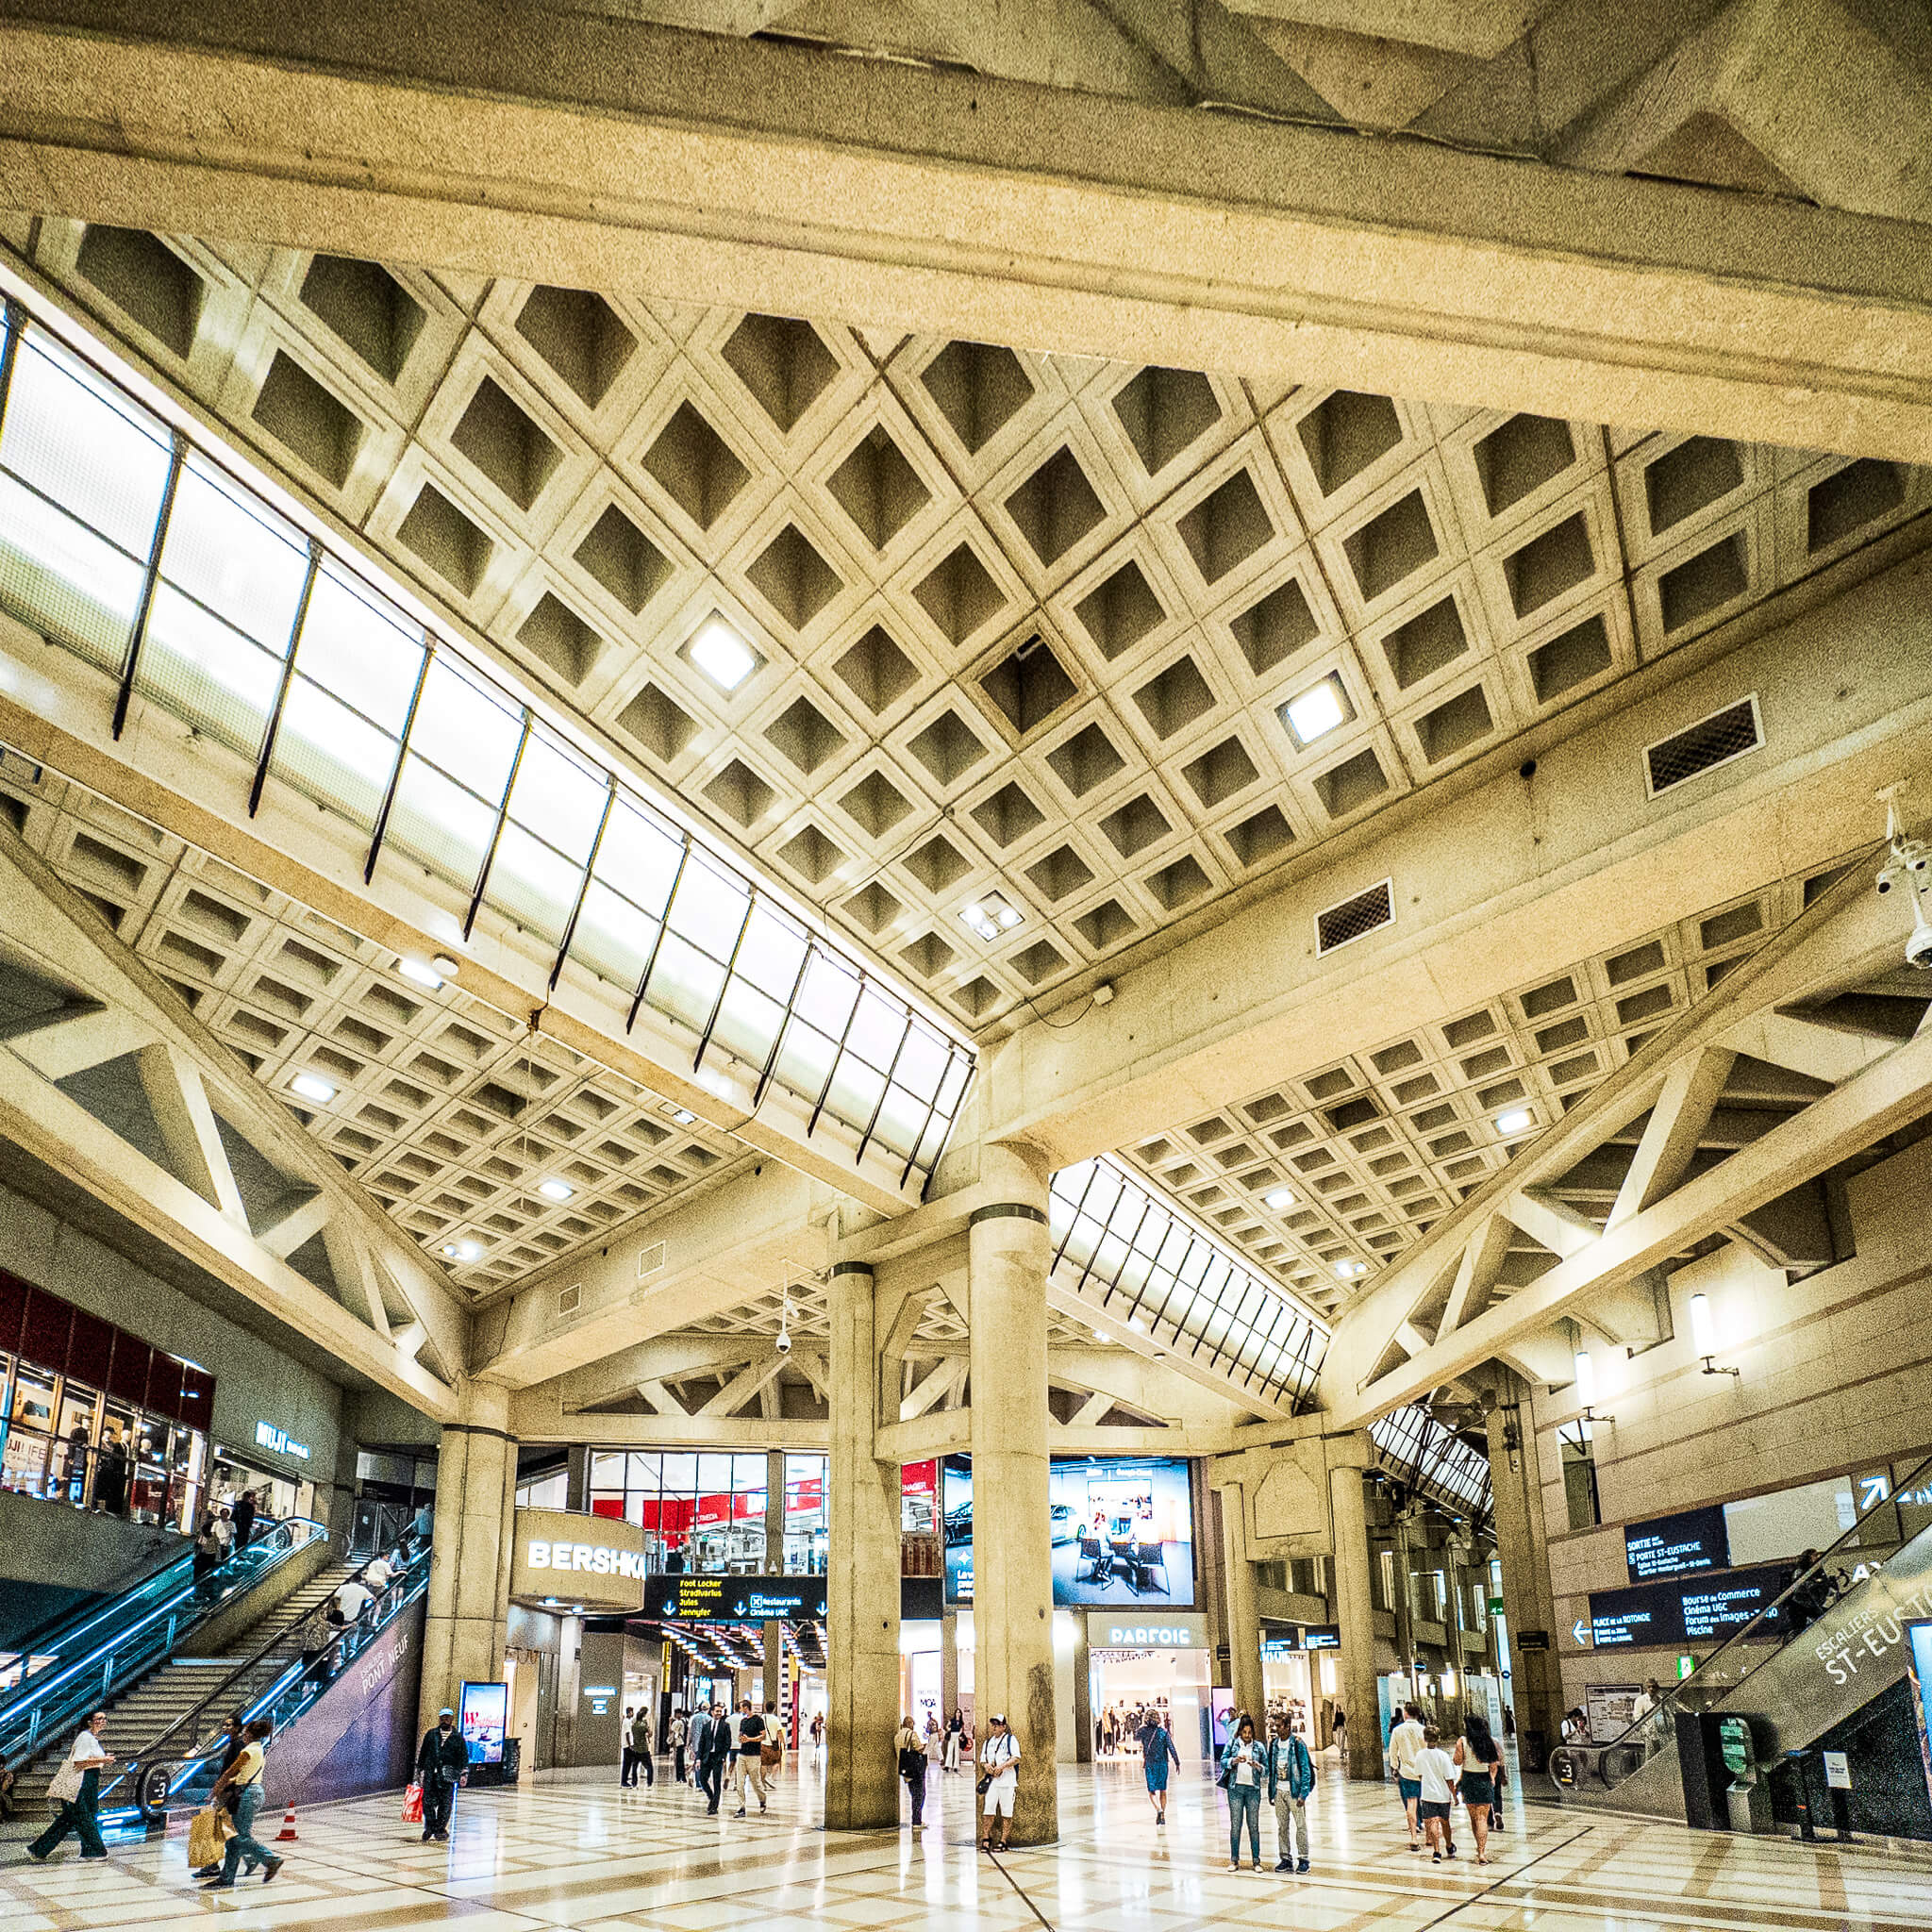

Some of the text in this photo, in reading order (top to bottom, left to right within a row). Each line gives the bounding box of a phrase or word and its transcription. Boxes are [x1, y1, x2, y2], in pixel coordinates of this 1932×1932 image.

[256, 1420, 287, 1454] MUJI
[1627, 1538, 1651, 1551] SORTIE
[1636, 1541, 1701, 1561] PORTE ST-EUSTACHE
[527, 1541, 646, 1581] BERSHKA
[679, 1590, 723, 1598] Stradivarius
[1682, 1595, 1709, 1606] Bourse
[1717, 1588, 1760, 1601] Commerce
[679, 1598, 698, 1607] Jules
[762, 1598, 802, 1607] Restaurants
[1683, 1603, 1727, 1616] Cinéma UGC
[679, 1608, 711, 1618] Jennyfer
[774, 1608, 790, 1617] UGC
[1685, 1614, 1709, 1625] Forum
[1720, 1611, 1749, 1623] images
[1593, 1617, 1609, 1627] PLACE
[1623, 1613, 1651, 1624] ROTONDE
[1110, 1628, 1190, 1644] PARFOIS
[1686, 1625, 1713, 1636] Piscine
[1815, 1606, 1879, 1660] ESCALIERS
[362, 1660, 385, 1695] PONT
[388, 1634, 408, 1666] NEUF
[1561, 1764, 1573, 1778] -3
[154, 1782, 166, 1797] -3
